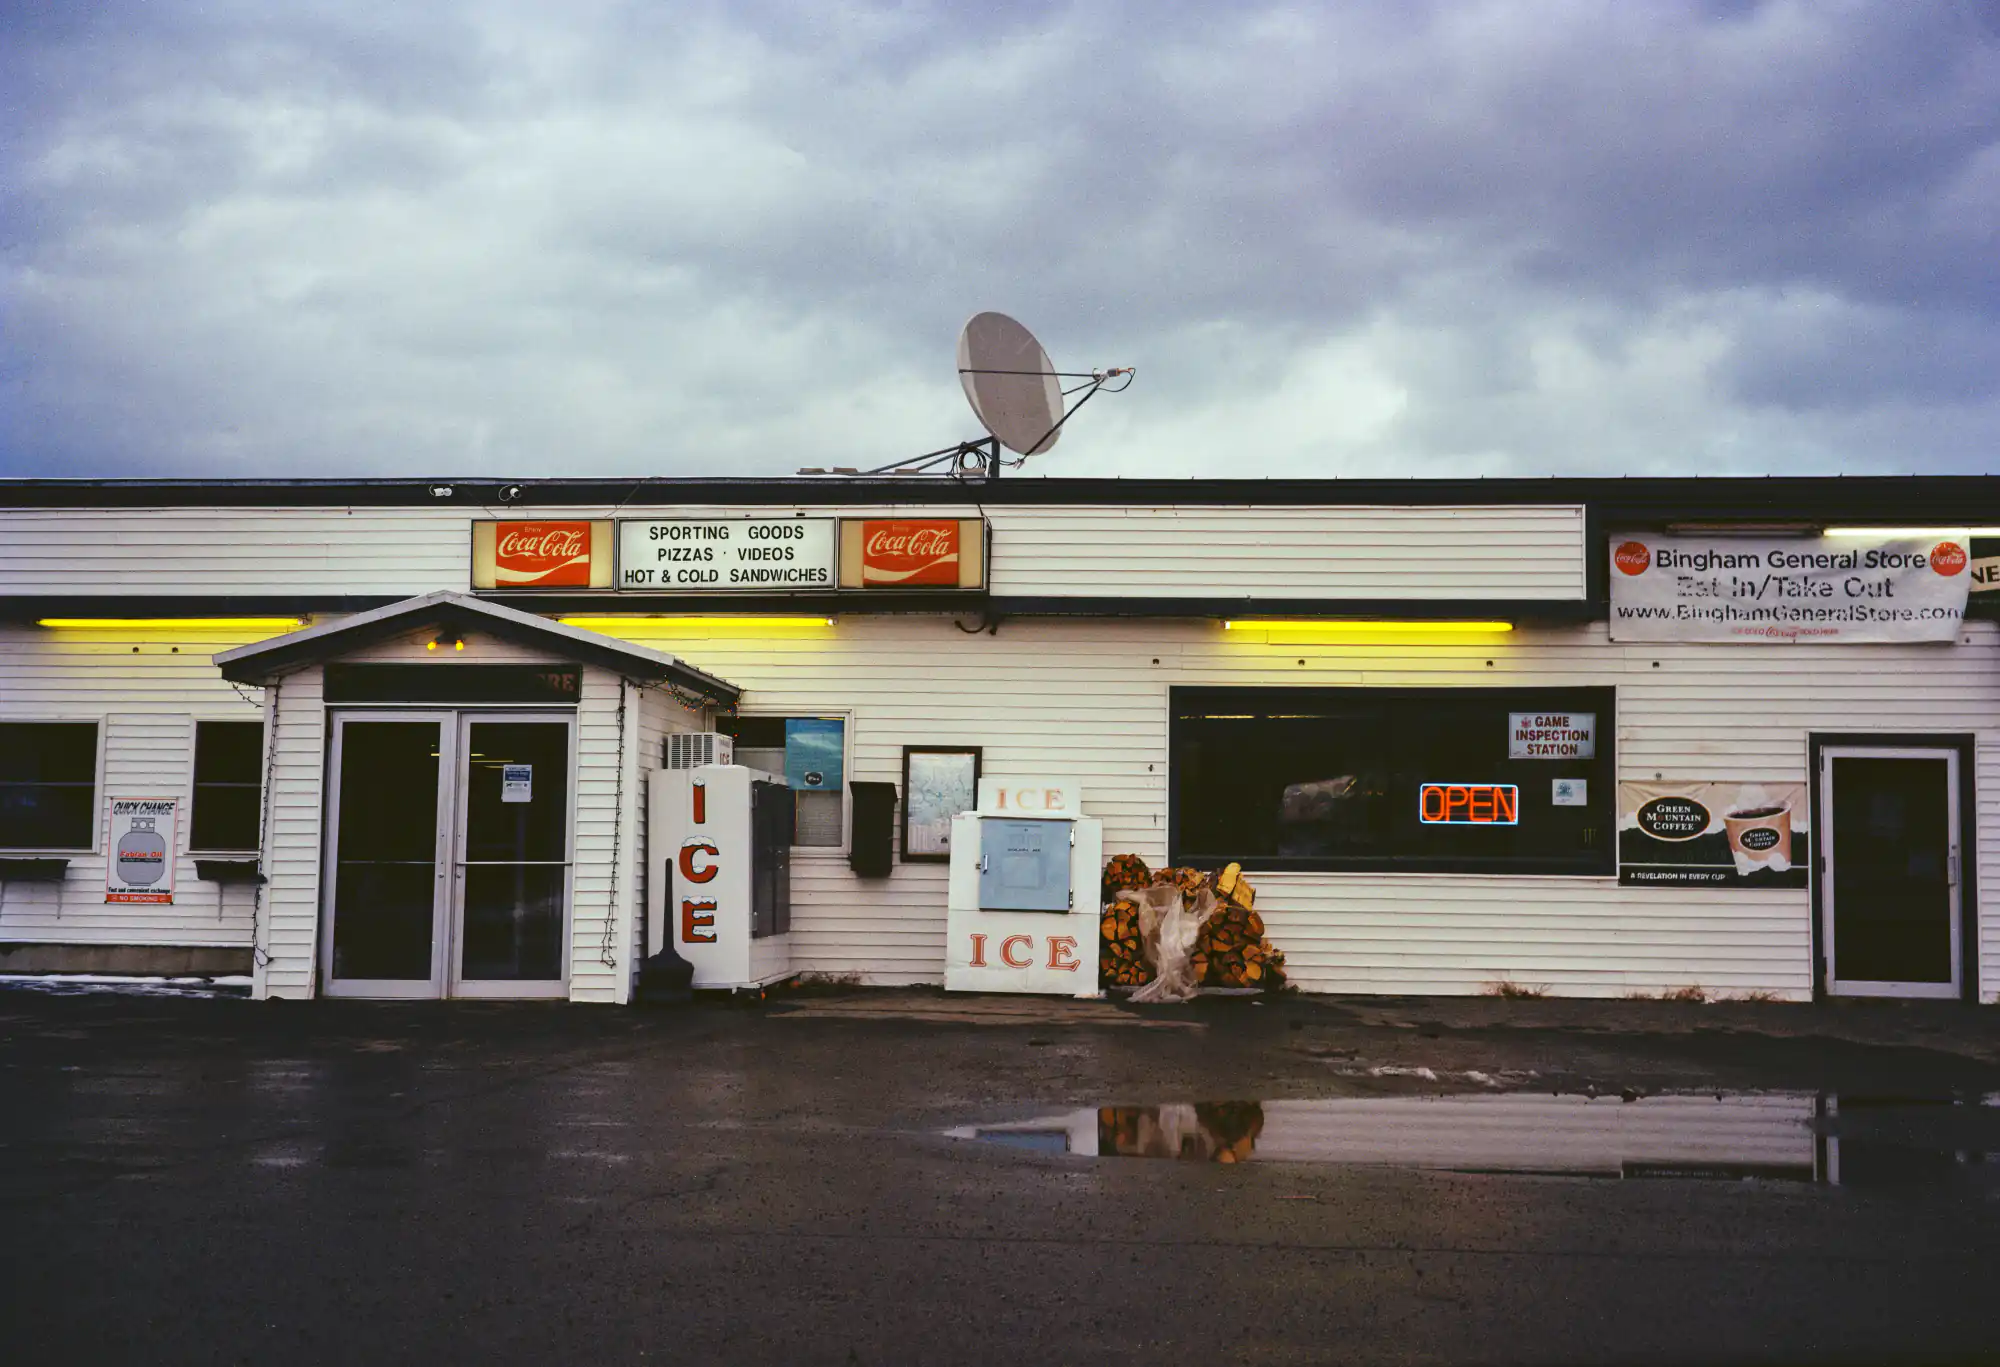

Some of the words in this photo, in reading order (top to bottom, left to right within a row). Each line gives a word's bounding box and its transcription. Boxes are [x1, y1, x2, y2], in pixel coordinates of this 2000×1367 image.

[649, 526, 730, 540] SPORTING
[748, 525, 804, 540] GOODS
[498, 530, 585, 558] Coca-Cola
[866, 529, 953, 557] Coca-Cola
[657, 547, 714, 561] PIZZAS
[737, 546, 795, 561] VIDEOS
[1616, 550, 1648, 564] Coca-Cola
[1656, 549, 1760, 571] Bingham
[1767, 549, 1857, 569] General
[1864, 549, 1926, 569] Store
[1931, 548, 1964, 565] Coca-Cola
[624, 569, 655, 583] HOT
[661, 570, 671, 583] &
[677, 569, 719, 583] COLD
[729, 568, 828, 582] SANDWICHES
[1732, 574, 1834, 600] In/Take
[1843, 576, 1895, 598] Out
[1617, 604, 1965, 624] www.BinghamGeneralStore.com
[1534, 716, 1570, 727] GAME
[1515, 730, 1589, 741] INSPECTION
[1526, 744, 1578, 755] STATION
[996, 788, 1066, 810] ICE
[1422, 786, 1517, 822] OPEN
[113, 802, 140, 815] QUICK
[139, 802, 175, 815] CHANGE
[1656, 804, 1691, 813] GREEN
[1646, 812, 1701, 822] MOUNTAIN
[1653, 821, 1695, 831] COFFEE
[679, 776, 720, 943] ICE
[969, 934, 1081, 972] ICE
